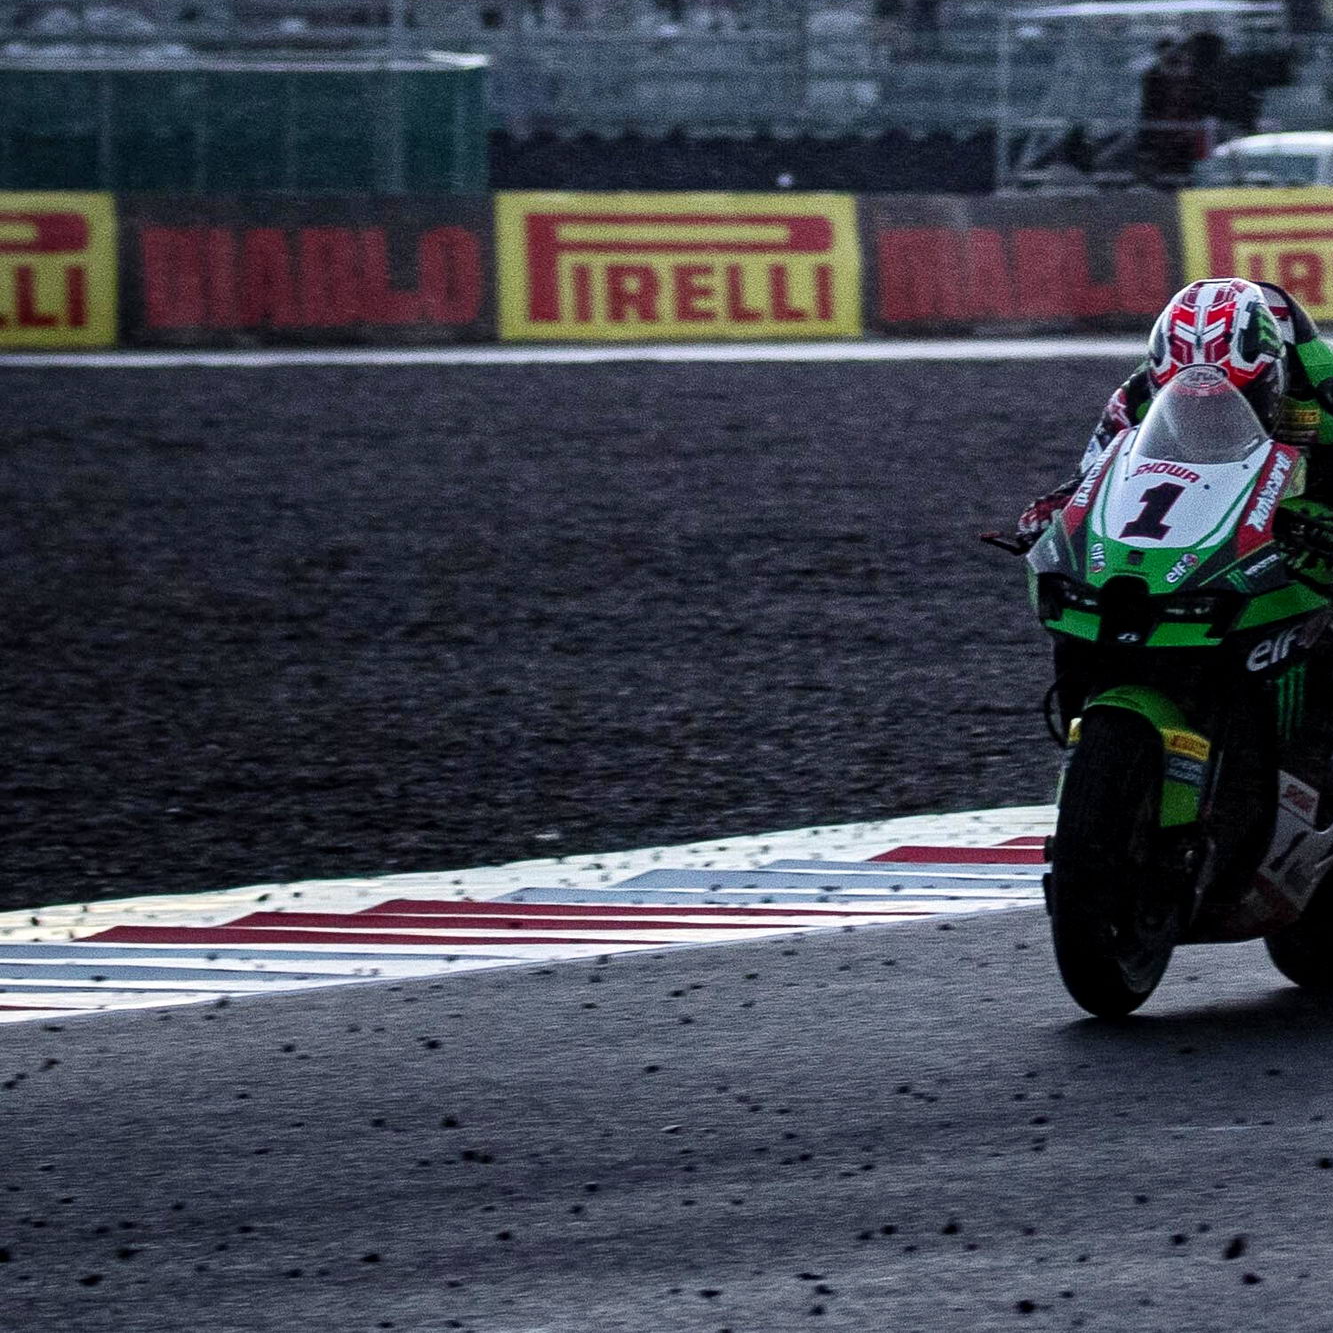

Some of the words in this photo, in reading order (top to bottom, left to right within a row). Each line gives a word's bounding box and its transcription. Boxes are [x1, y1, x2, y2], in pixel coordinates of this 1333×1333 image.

[526, 212, 833, 322] PIRELLI
[1131, 462, 1200, 483] SHOWA
[1118, 481, 1187, 541] 1
[1165, 559, 1189, 583] elf
[1246, 627, 1301, 672] elf
